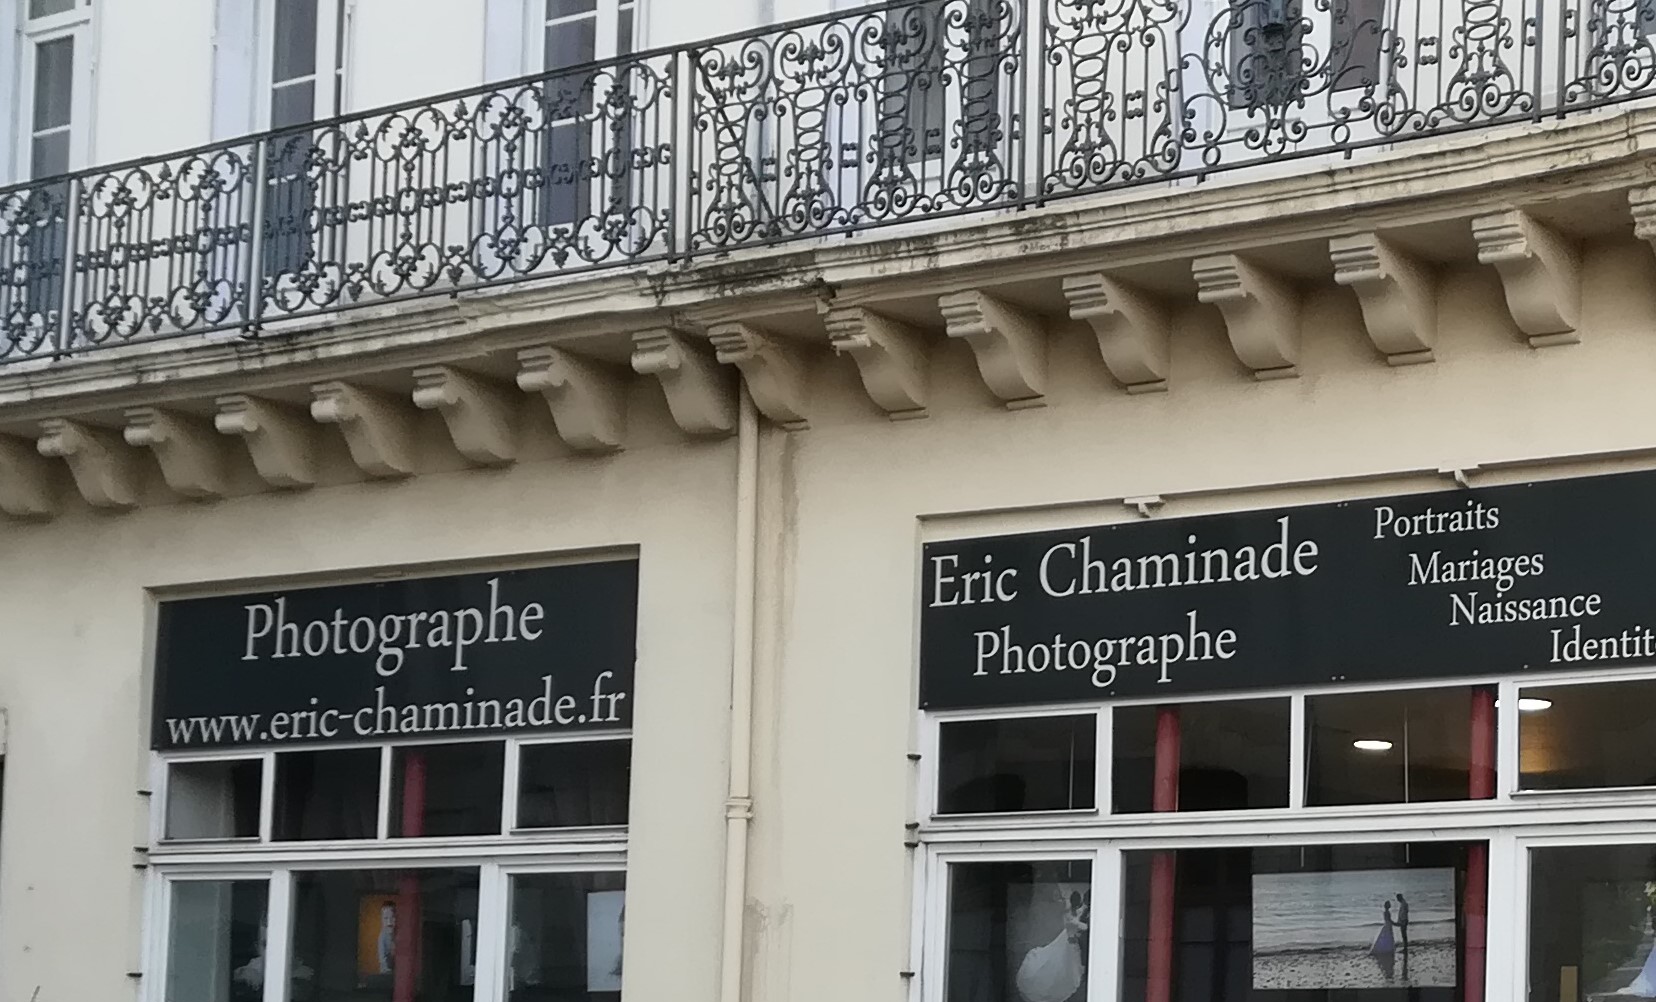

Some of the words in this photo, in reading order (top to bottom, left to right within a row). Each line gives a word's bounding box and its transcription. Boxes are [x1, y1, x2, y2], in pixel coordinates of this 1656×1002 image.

[1374, 500, 1500, 539] Portraits
[929, 554, 1018, 608] Eric
[1039, 515, 1319, 598] Chaminade
[1407, 549, 1545, 593] Mariages
[241, 577, 544, 677] Photographe
[1449, 592, 1602, 627] Naissance
[972, 609, 1237, 688] Photographe
[165, 670, 627, 744] www.eric-chaminade.fr
